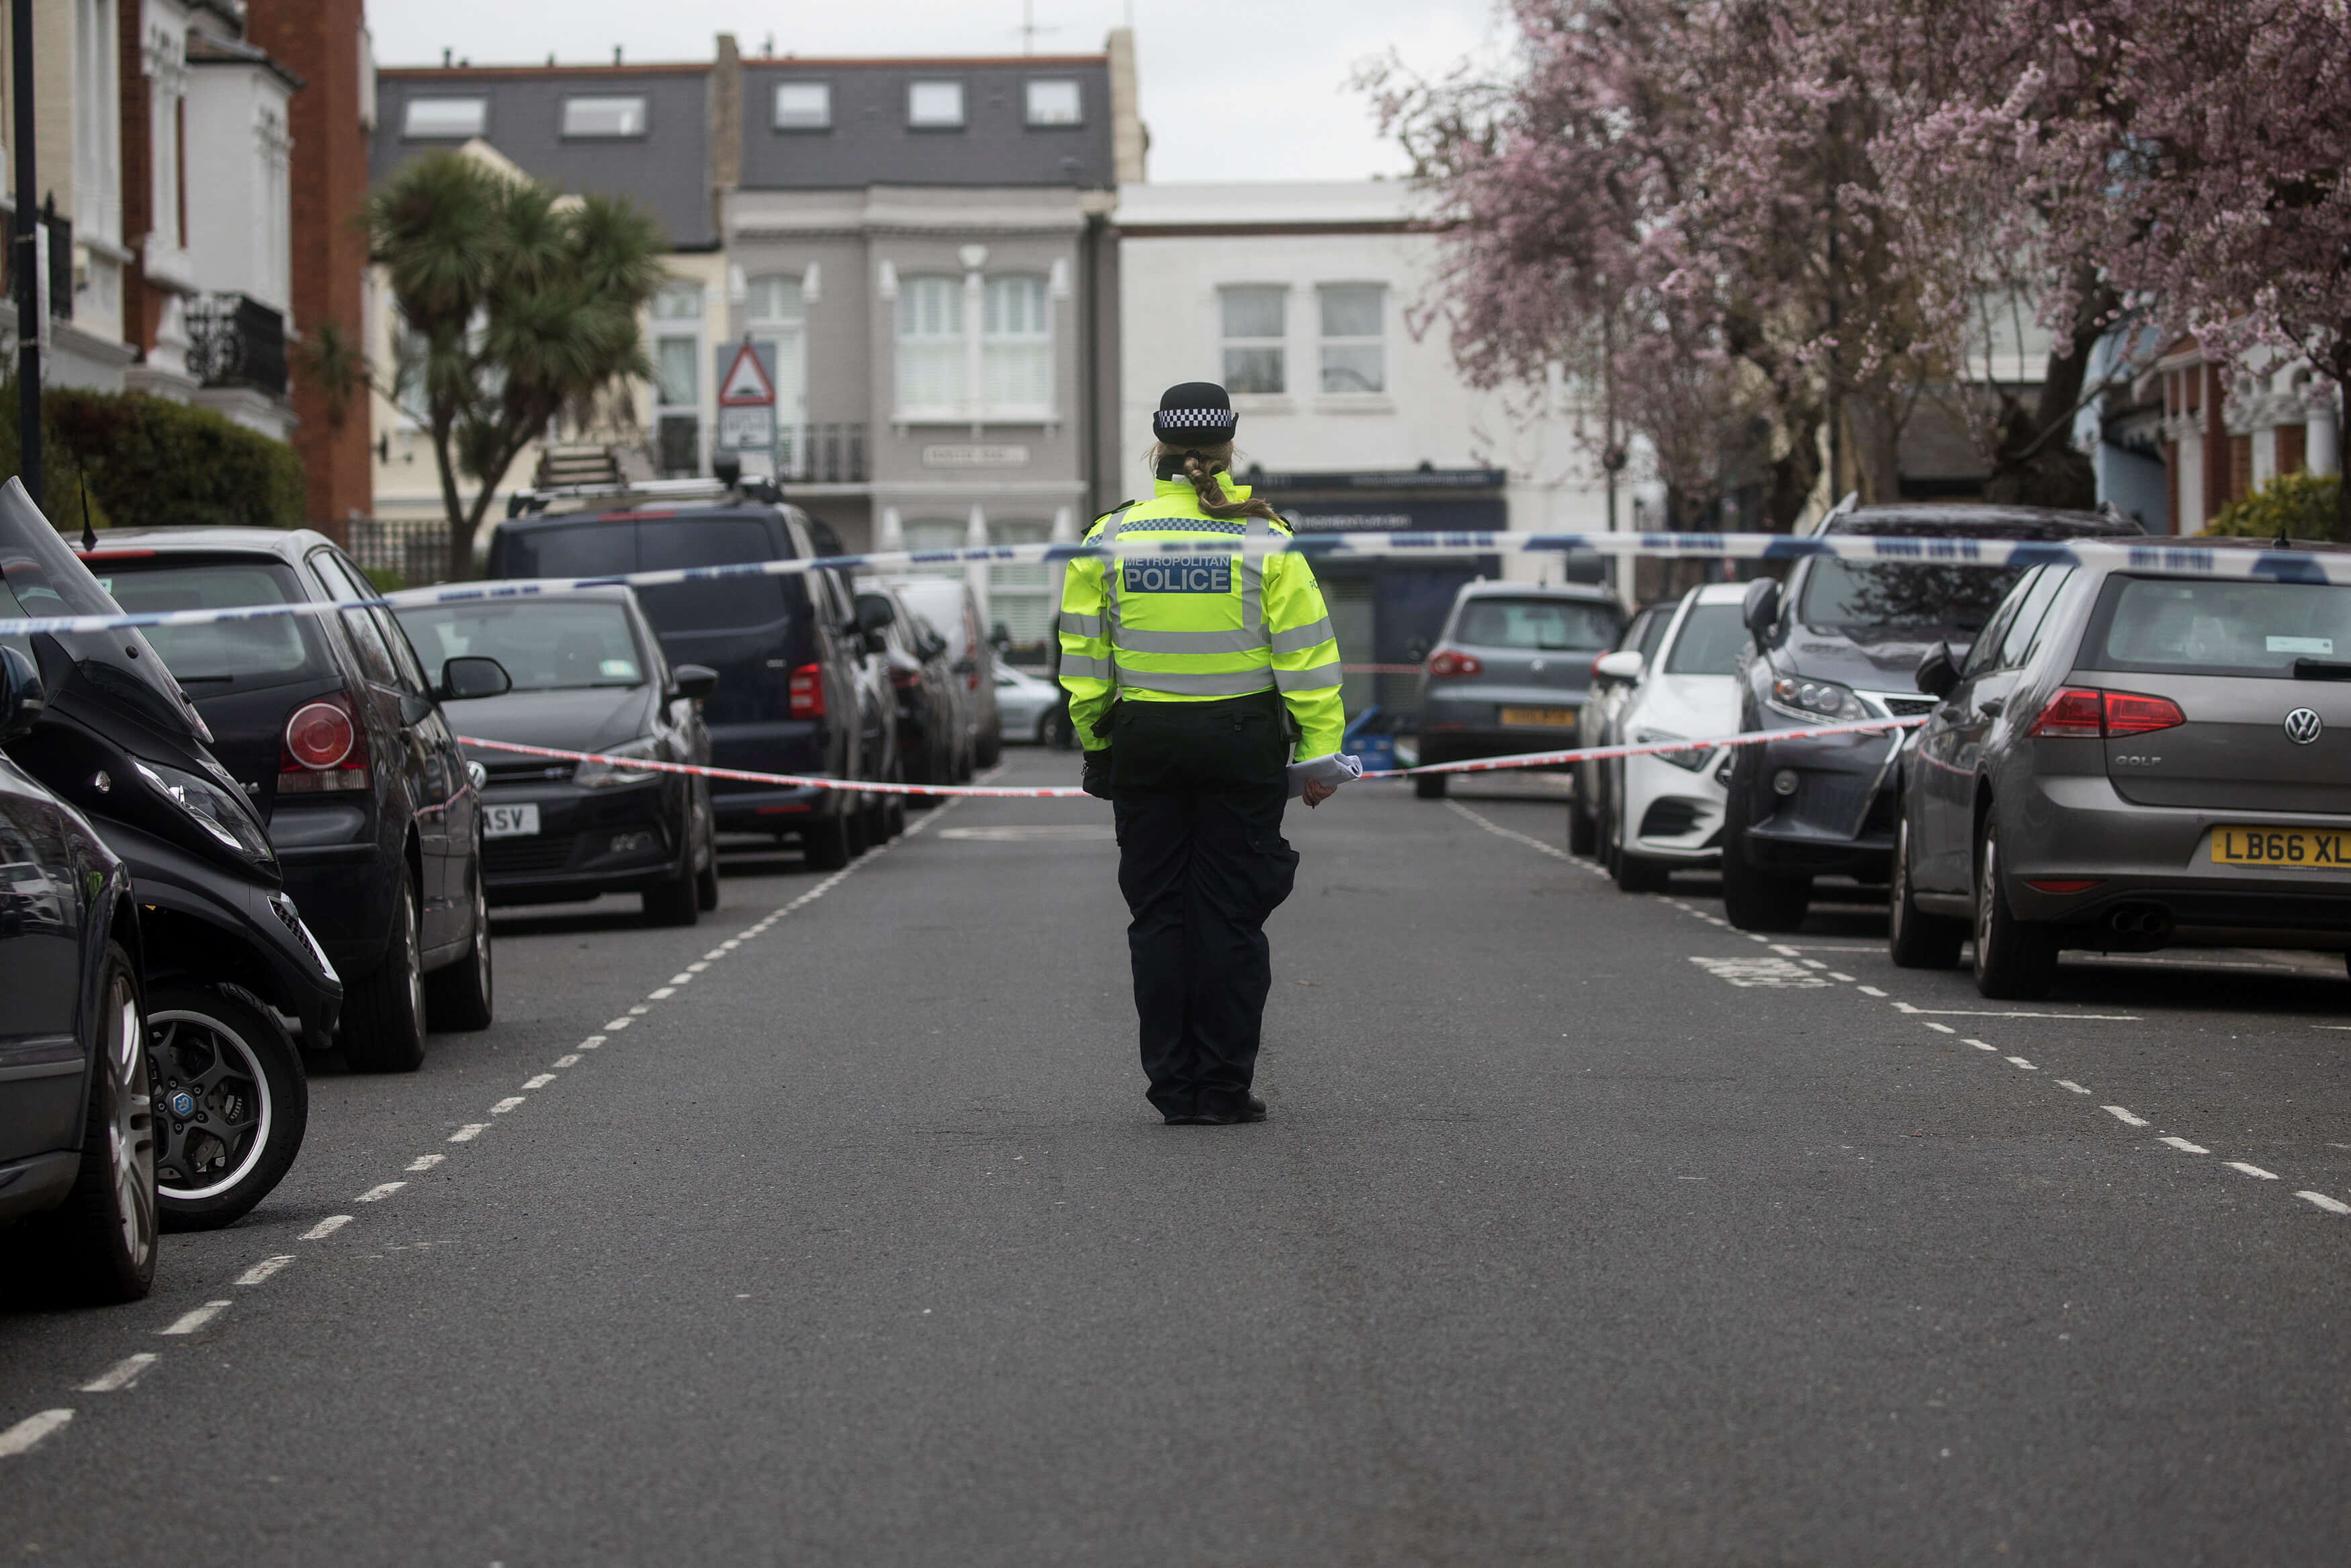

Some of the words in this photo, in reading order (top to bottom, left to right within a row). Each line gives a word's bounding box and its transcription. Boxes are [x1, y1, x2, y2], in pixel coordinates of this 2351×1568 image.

[1125, 556, 1229, 567] METROPOLITAN
[1124, 568, 1229, 591] POLICE
[2116, 755, 2162, 766] GOLF
[483, 808, 523, 831] ASV
[2225, 832, 2305, 862] LB66
